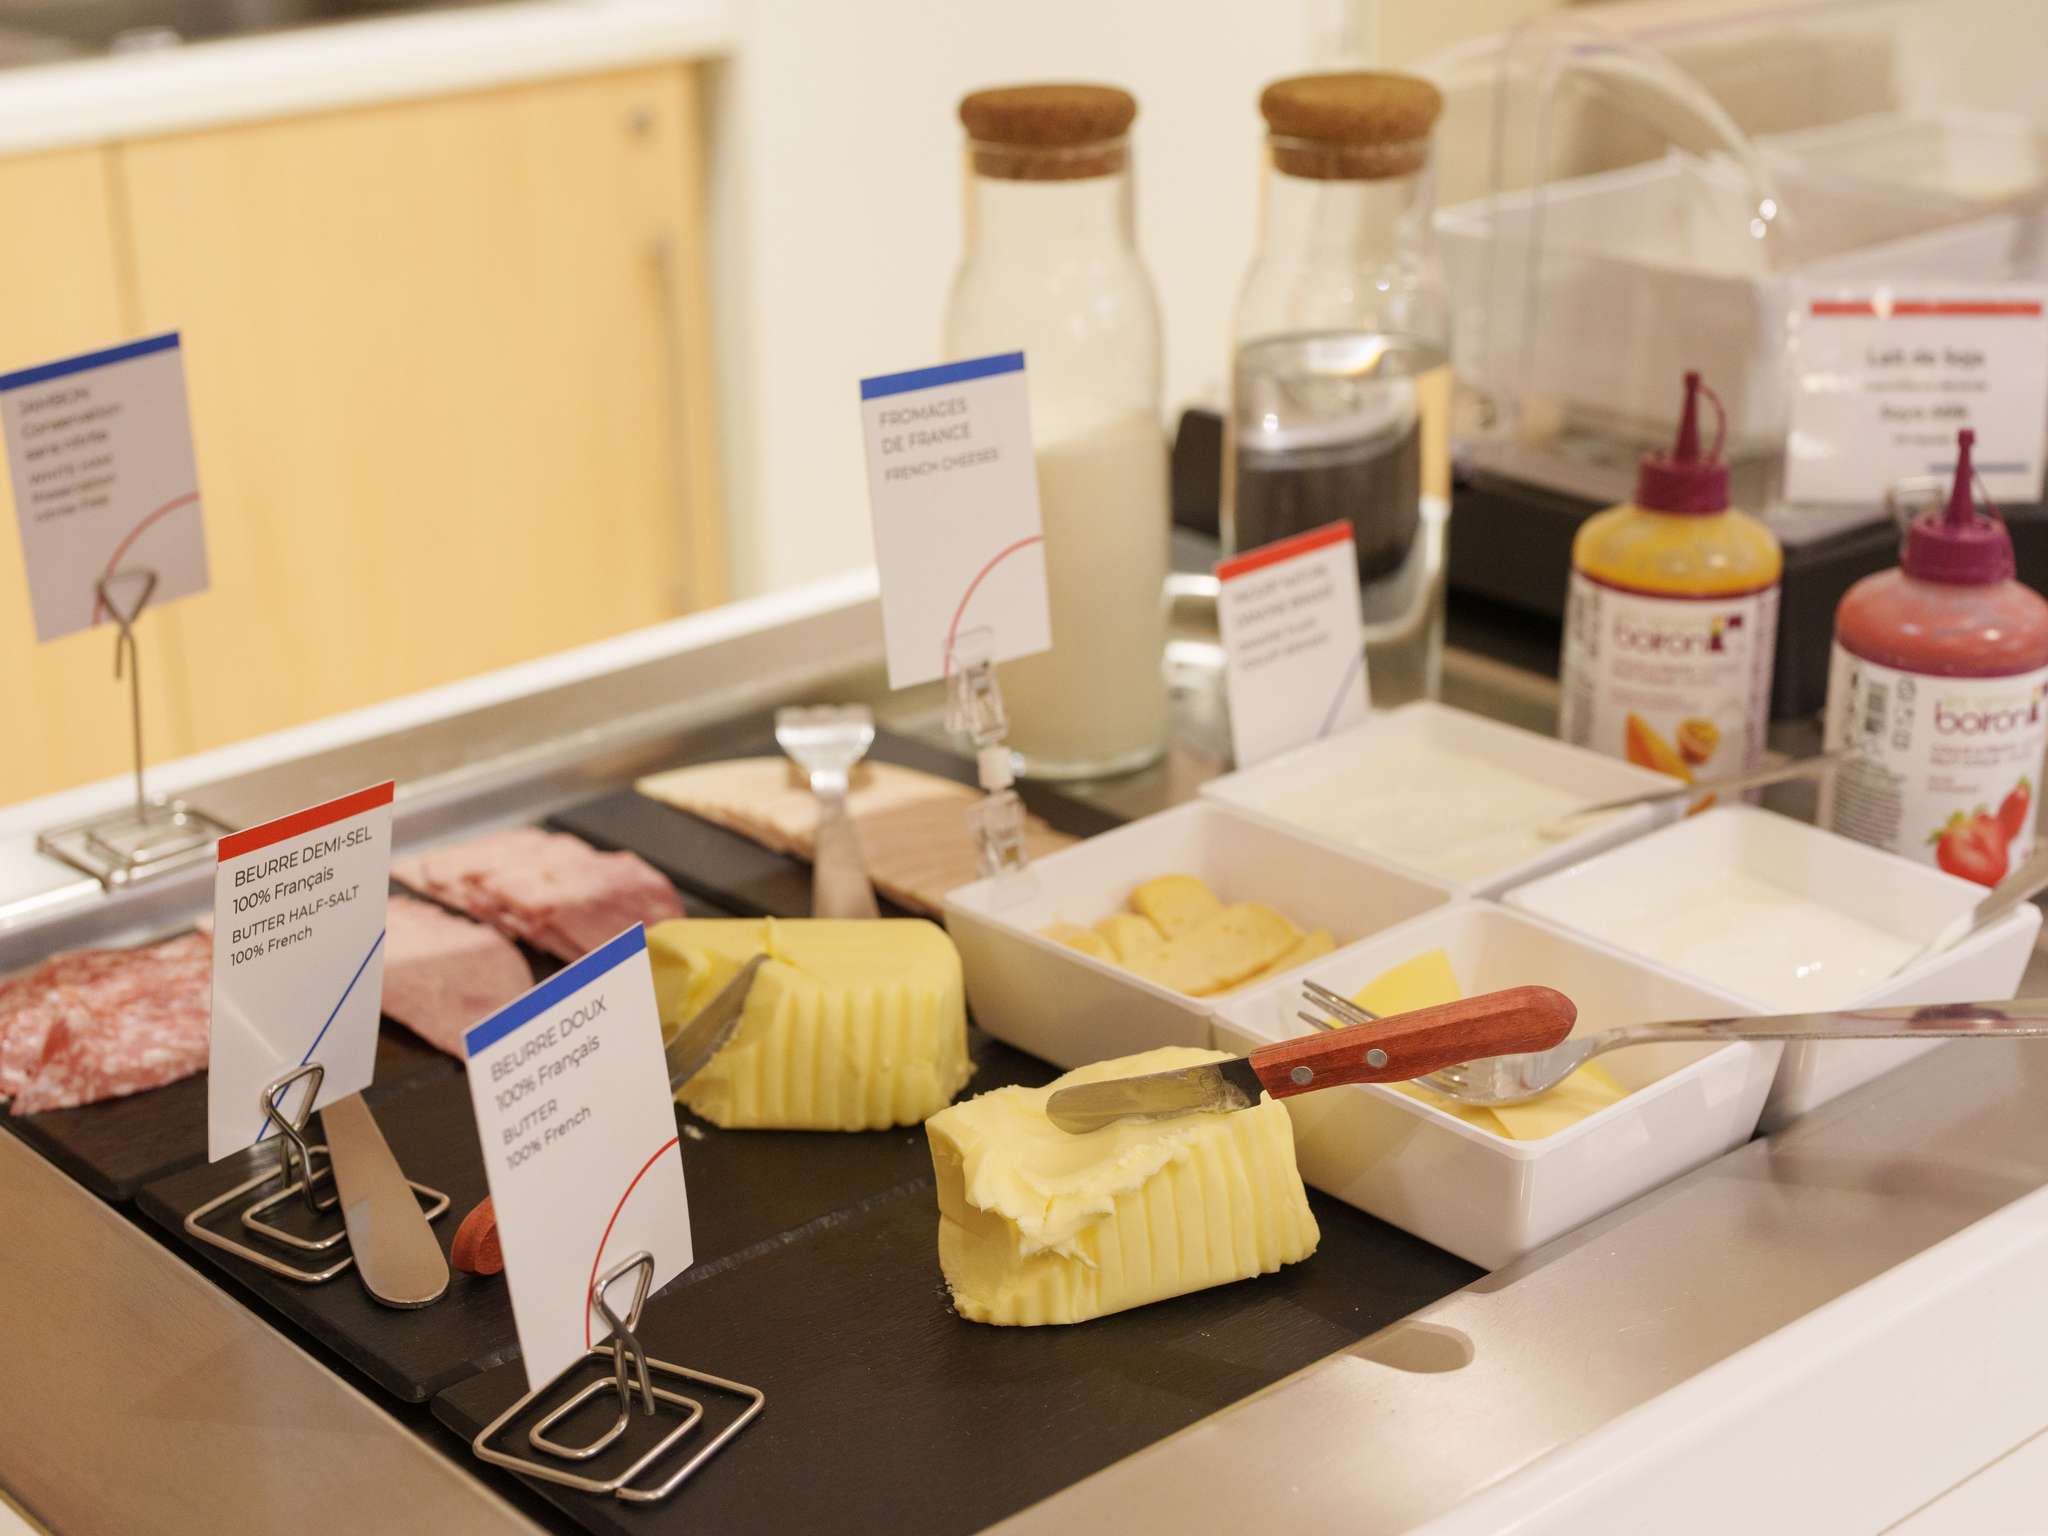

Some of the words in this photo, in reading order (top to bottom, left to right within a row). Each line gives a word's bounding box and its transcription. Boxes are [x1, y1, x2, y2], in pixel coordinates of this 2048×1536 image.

[879, 397, 968, 427] FROMAGES
[881, 437, 903, 455] DE
[909, 422, 971, 449] FRANCE
[885, 461, 939, 483] FRENCH
[942, 447, 999, 471] CHEESES
[234, 850, 299, 888] BEURRE
[302, 826, 373, 864] DEMI-SEL
[232, 889, 271, 915] 100%
[274, 866, 334, 900] Français
[232, 913, 285, 944] BUTTER
[289, 885, 360, 923] HALF-SALT
[230, 944, 264, 966] 100%
[268, 925, 313, 953] French
[491, 1028, 558, 1083] BEURRE
[560, 994, 608, 1038] DOUX
[495, 1076, 536, 1112] 100%
[539, 1034, 601, 1084] Français
[502, 1099, 558, 1145] BUTTER
[505, 1138, 542, 1169] 100%
[544, 1106, 592, 1145] French
